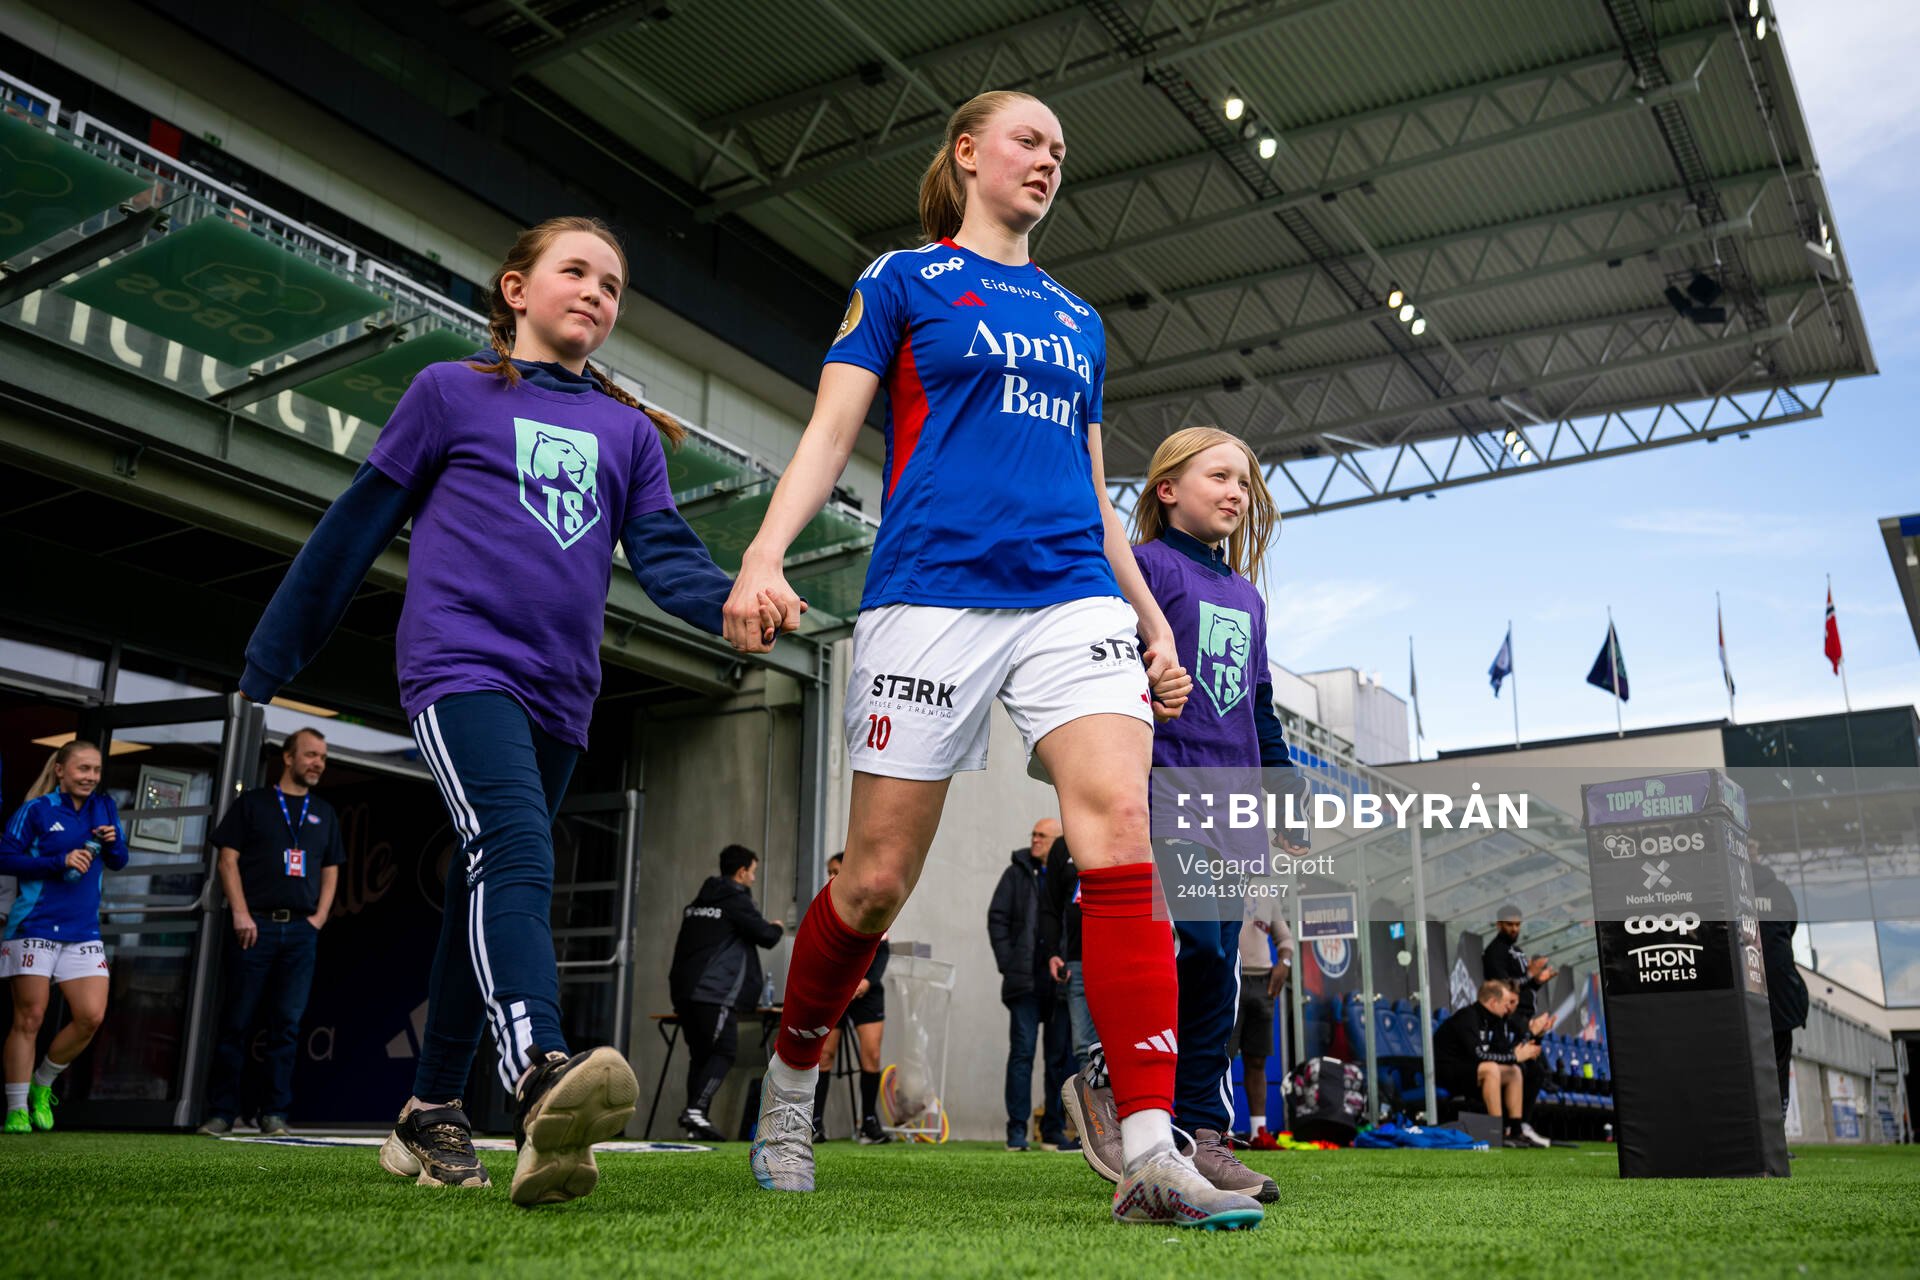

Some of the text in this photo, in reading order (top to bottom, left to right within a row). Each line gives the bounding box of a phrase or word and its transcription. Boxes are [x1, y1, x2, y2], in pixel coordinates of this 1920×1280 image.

[920, 257, 965, 280] coop
[963, 320, 1092, 384] Aprila
[541, 485, 584, 535] TS
[871, 674, 957, 708] STERK
[1212, 662, 1241, 704] TS
[867, 713, 892, 751] 10
[1606, 790, 1643, 812] TOPP
[1642, 795, 1693, 818] SERIEN
[1641, 833, 1705, 855] OBOS
[1626, 891, 1693, 905] Norsk Tipping
[1624, 911, 1701, 936] coop
[21, 953, 34, 968] 18
[1628, 944, 1704, 968] THON
[1640, 968, 1697, 983] HOTELS
